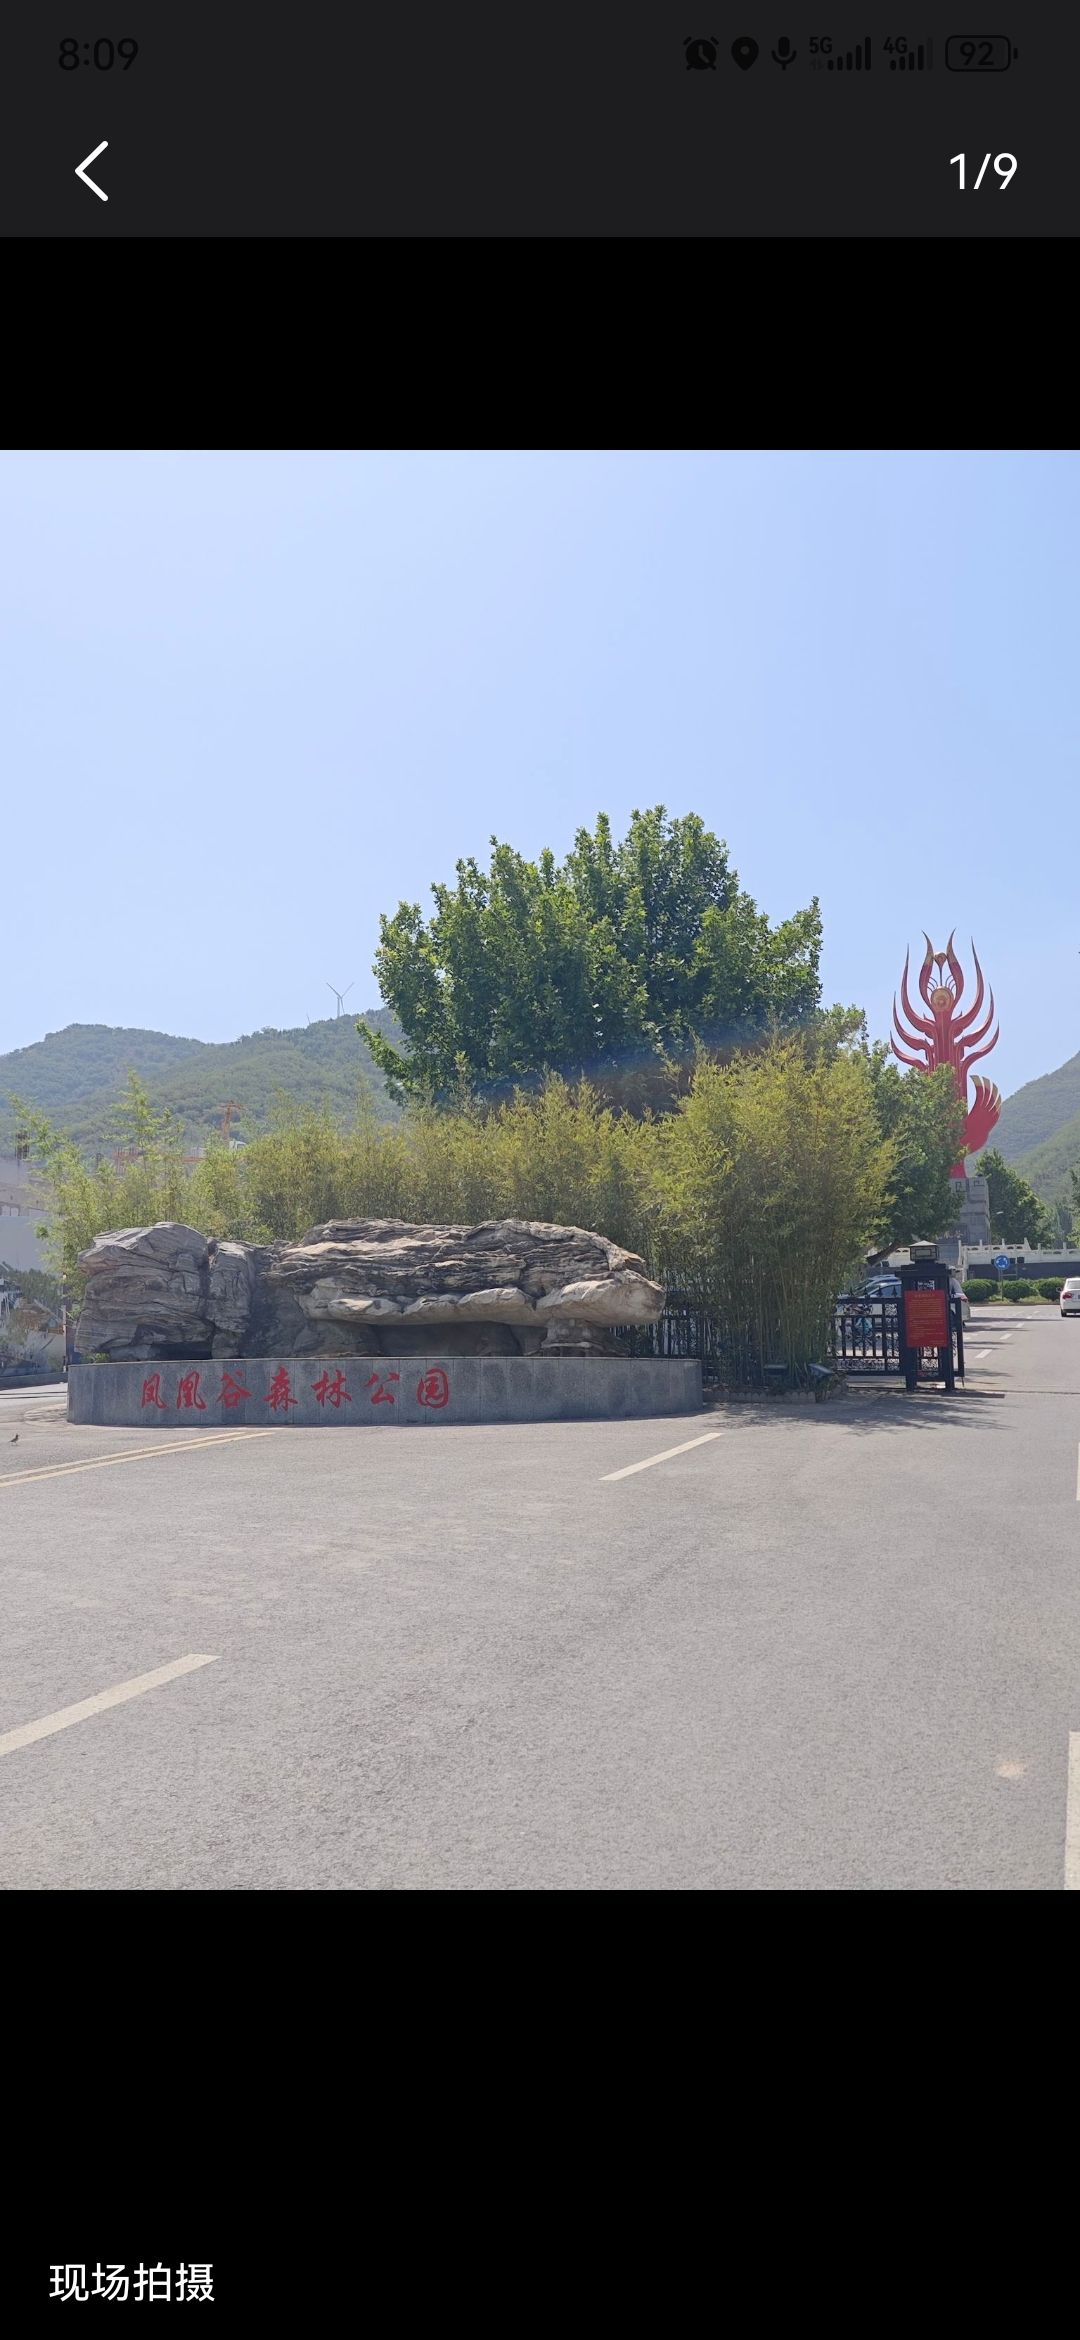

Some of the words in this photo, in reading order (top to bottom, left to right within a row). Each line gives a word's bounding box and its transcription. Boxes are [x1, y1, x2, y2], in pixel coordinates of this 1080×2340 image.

[140, 1366, 450, 1413] 凤凰谷森林公园
